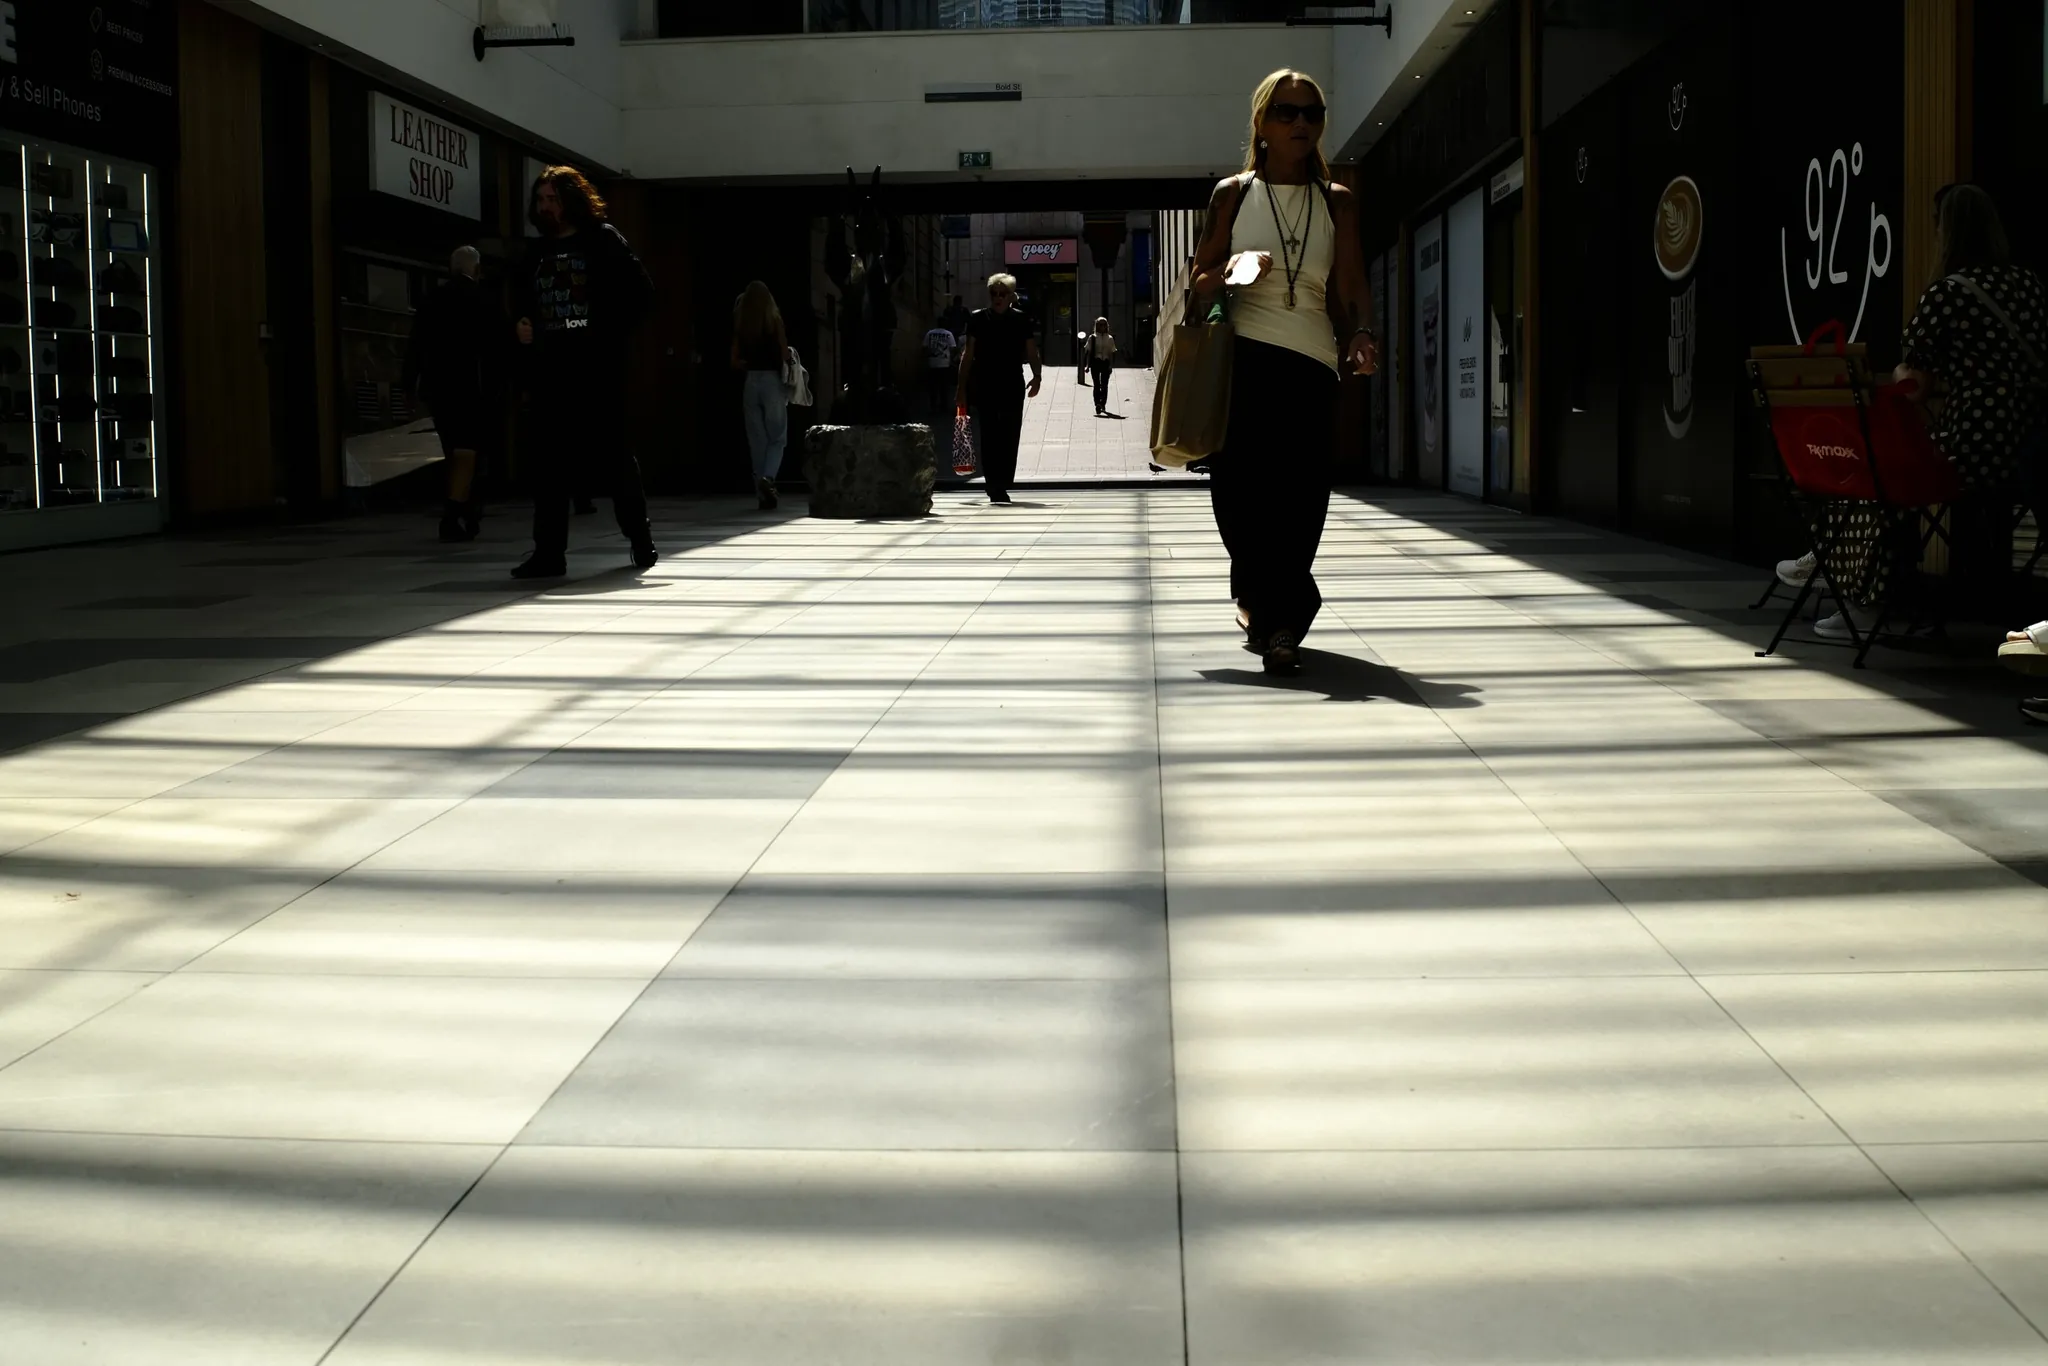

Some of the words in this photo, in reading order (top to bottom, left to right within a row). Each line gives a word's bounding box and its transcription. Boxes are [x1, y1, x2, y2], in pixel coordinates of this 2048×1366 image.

[105, 20, 122, 36] BEST
[122, 26, 144, 44] PRICES
[106, 65, 134, 83] PREMIUM
[10, 76, 20, 99] &
[23, 78, 50, 108] Sell
[52, 88, 101, 122] Phones
[390, 103, 468, 169] LEATHER
[409, 157, 454, 204] SHOP
[1022, 243, 1062, 260] gooey
